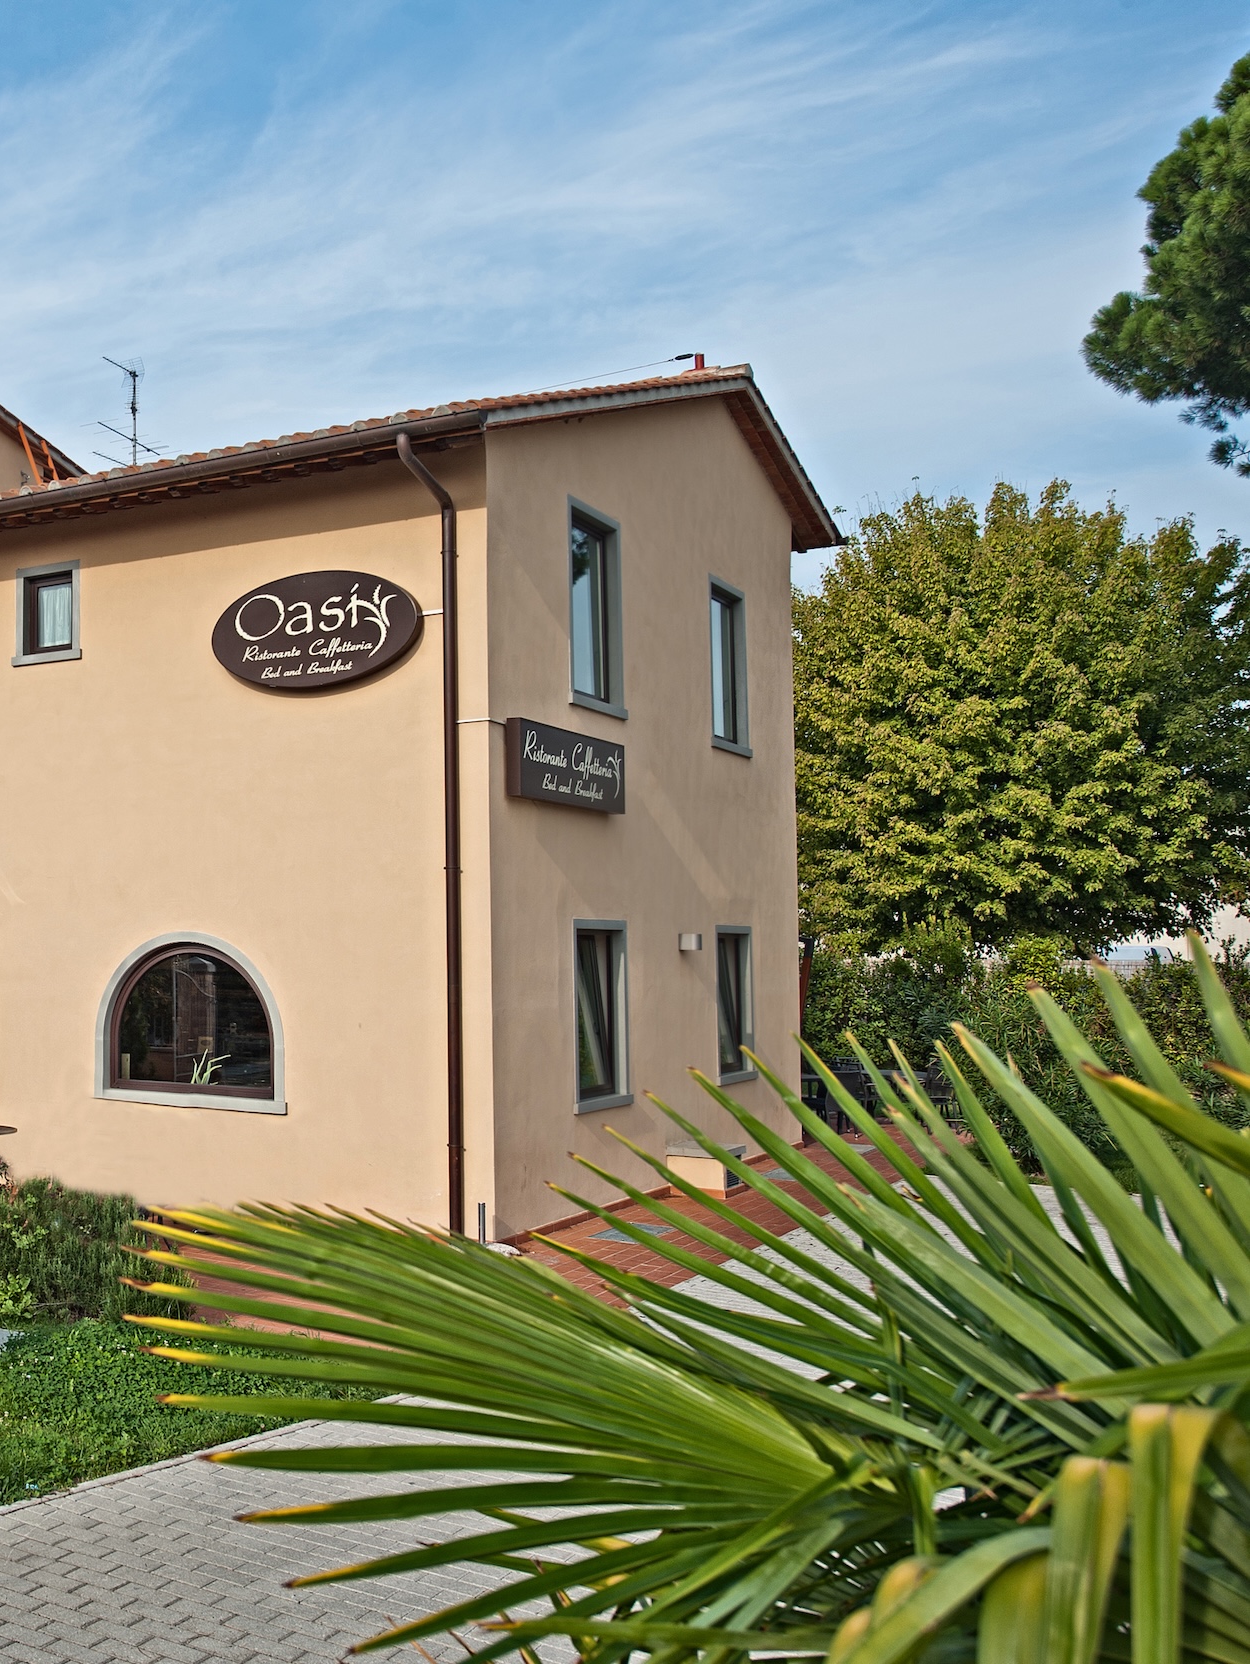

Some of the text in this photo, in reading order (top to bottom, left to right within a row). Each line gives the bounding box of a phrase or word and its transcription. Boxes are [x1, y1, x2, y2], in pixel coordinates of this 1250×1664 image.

[242, 637, 373, 662] Ristorante Caffetteria
[261, 659, 353, 679] Bed and Breakfast
[523, 730, 613, 780] Ristorante Caffetteria
[542, 773, 604, 802] Bed and Breakfast
